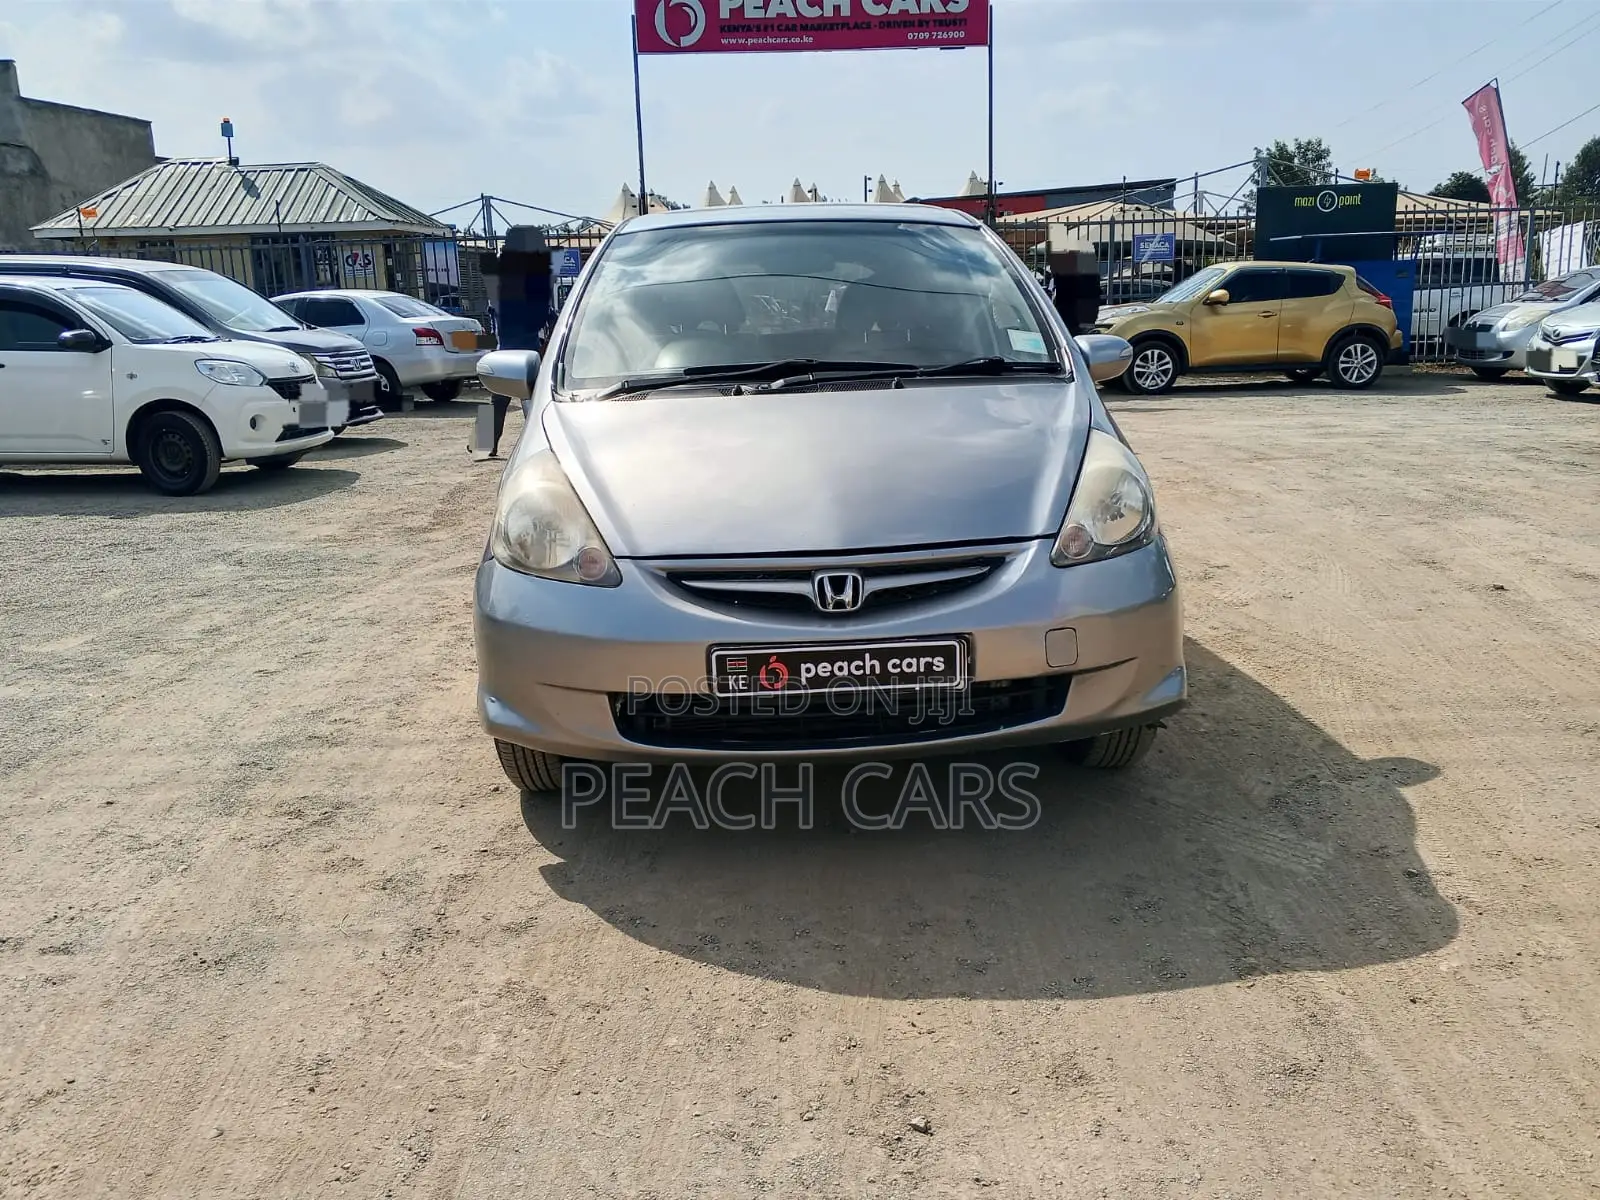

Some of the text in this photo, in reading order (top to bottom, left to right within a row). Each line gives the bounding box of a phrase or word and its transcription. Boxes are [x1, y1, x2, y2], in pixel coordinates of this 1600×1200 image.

[719, 23, 762, 33] KENYA'S
[777, 23, 798, 33] CAR
[800, 21, 872, 33] MARKETPLACE
[880, 20, 915, 29] DRIVEN
[918, 19, 930, 28] BY
[721, 35, 814, 45] www.peachcars.co.ke
[907, 31, 965, 40] 0709 726900
[1294, 193, 1362, 209] mazi point
[800, 652, 945, 685] peach cars
[728, 675, 748, 690] KE
